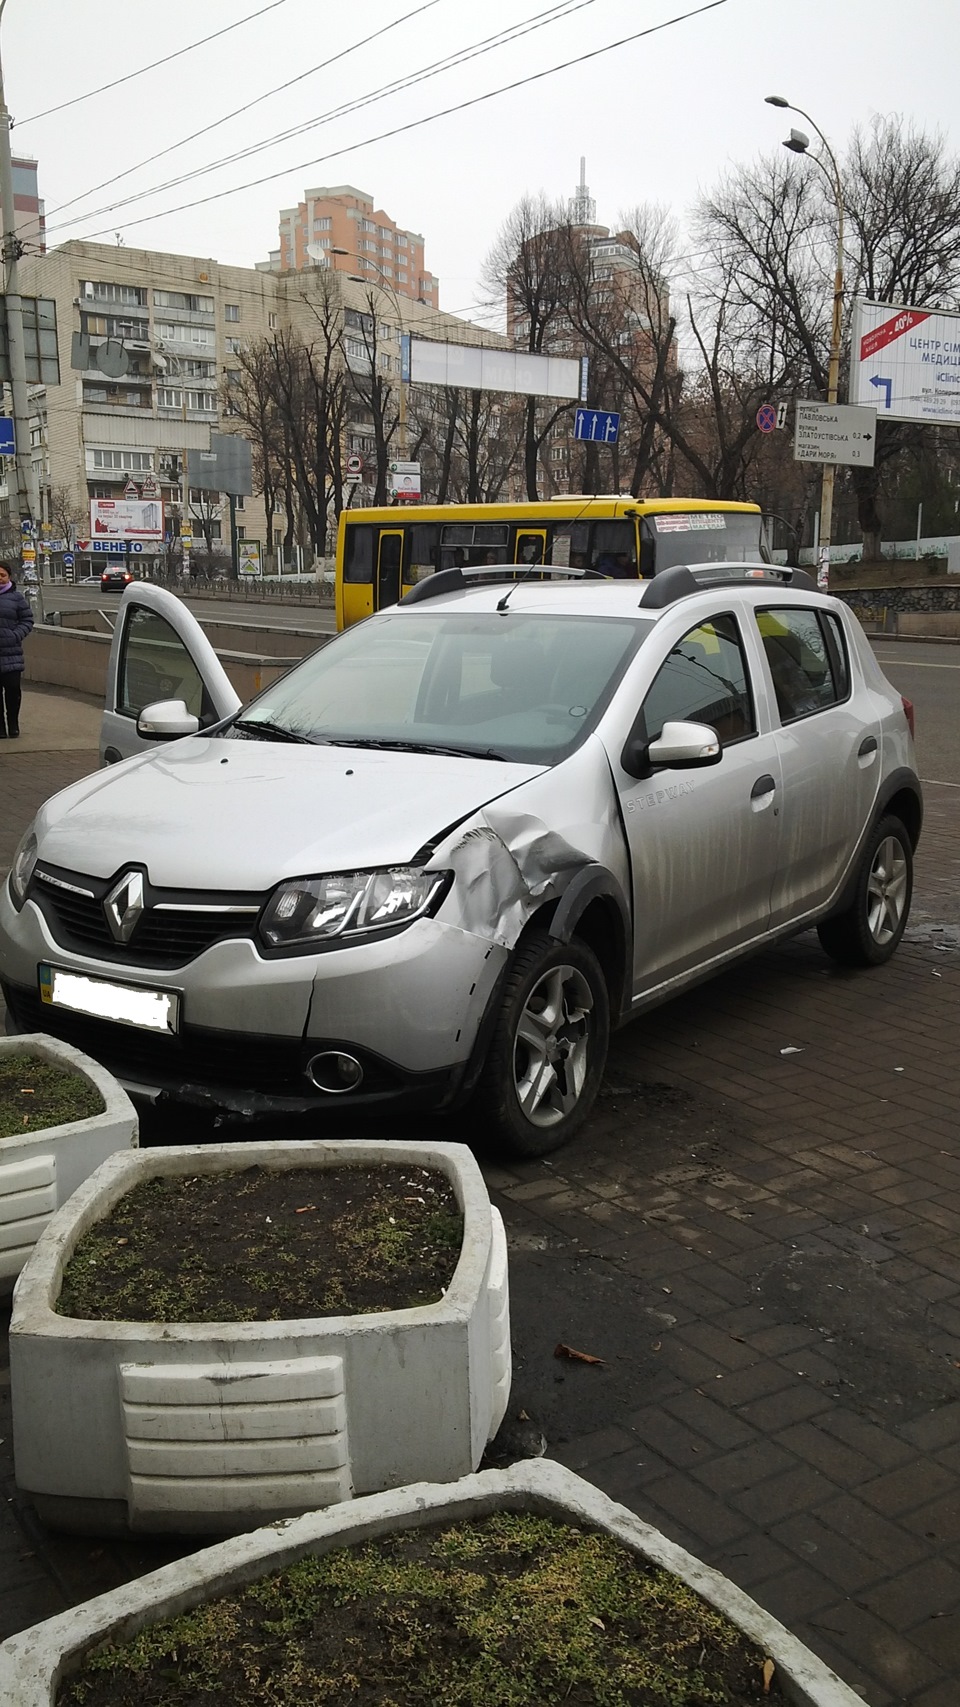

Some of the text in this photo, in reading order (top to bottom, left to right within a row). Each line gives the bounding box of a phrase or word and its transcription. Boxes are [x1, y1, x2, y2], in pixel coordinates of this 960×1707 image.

[910, 337, 941, 351] ЦЕНТР
[800, 412, 838, 422] ПАВЛОВСЬКА
[799, 431, 848, 441] ЗЛАТОУСТІВСЬКА
[93, 541, 143, 553] ВЕНЕТО
[626, 780, 695, 814] STEPWAY
[42, 989, 51, 998] UA
